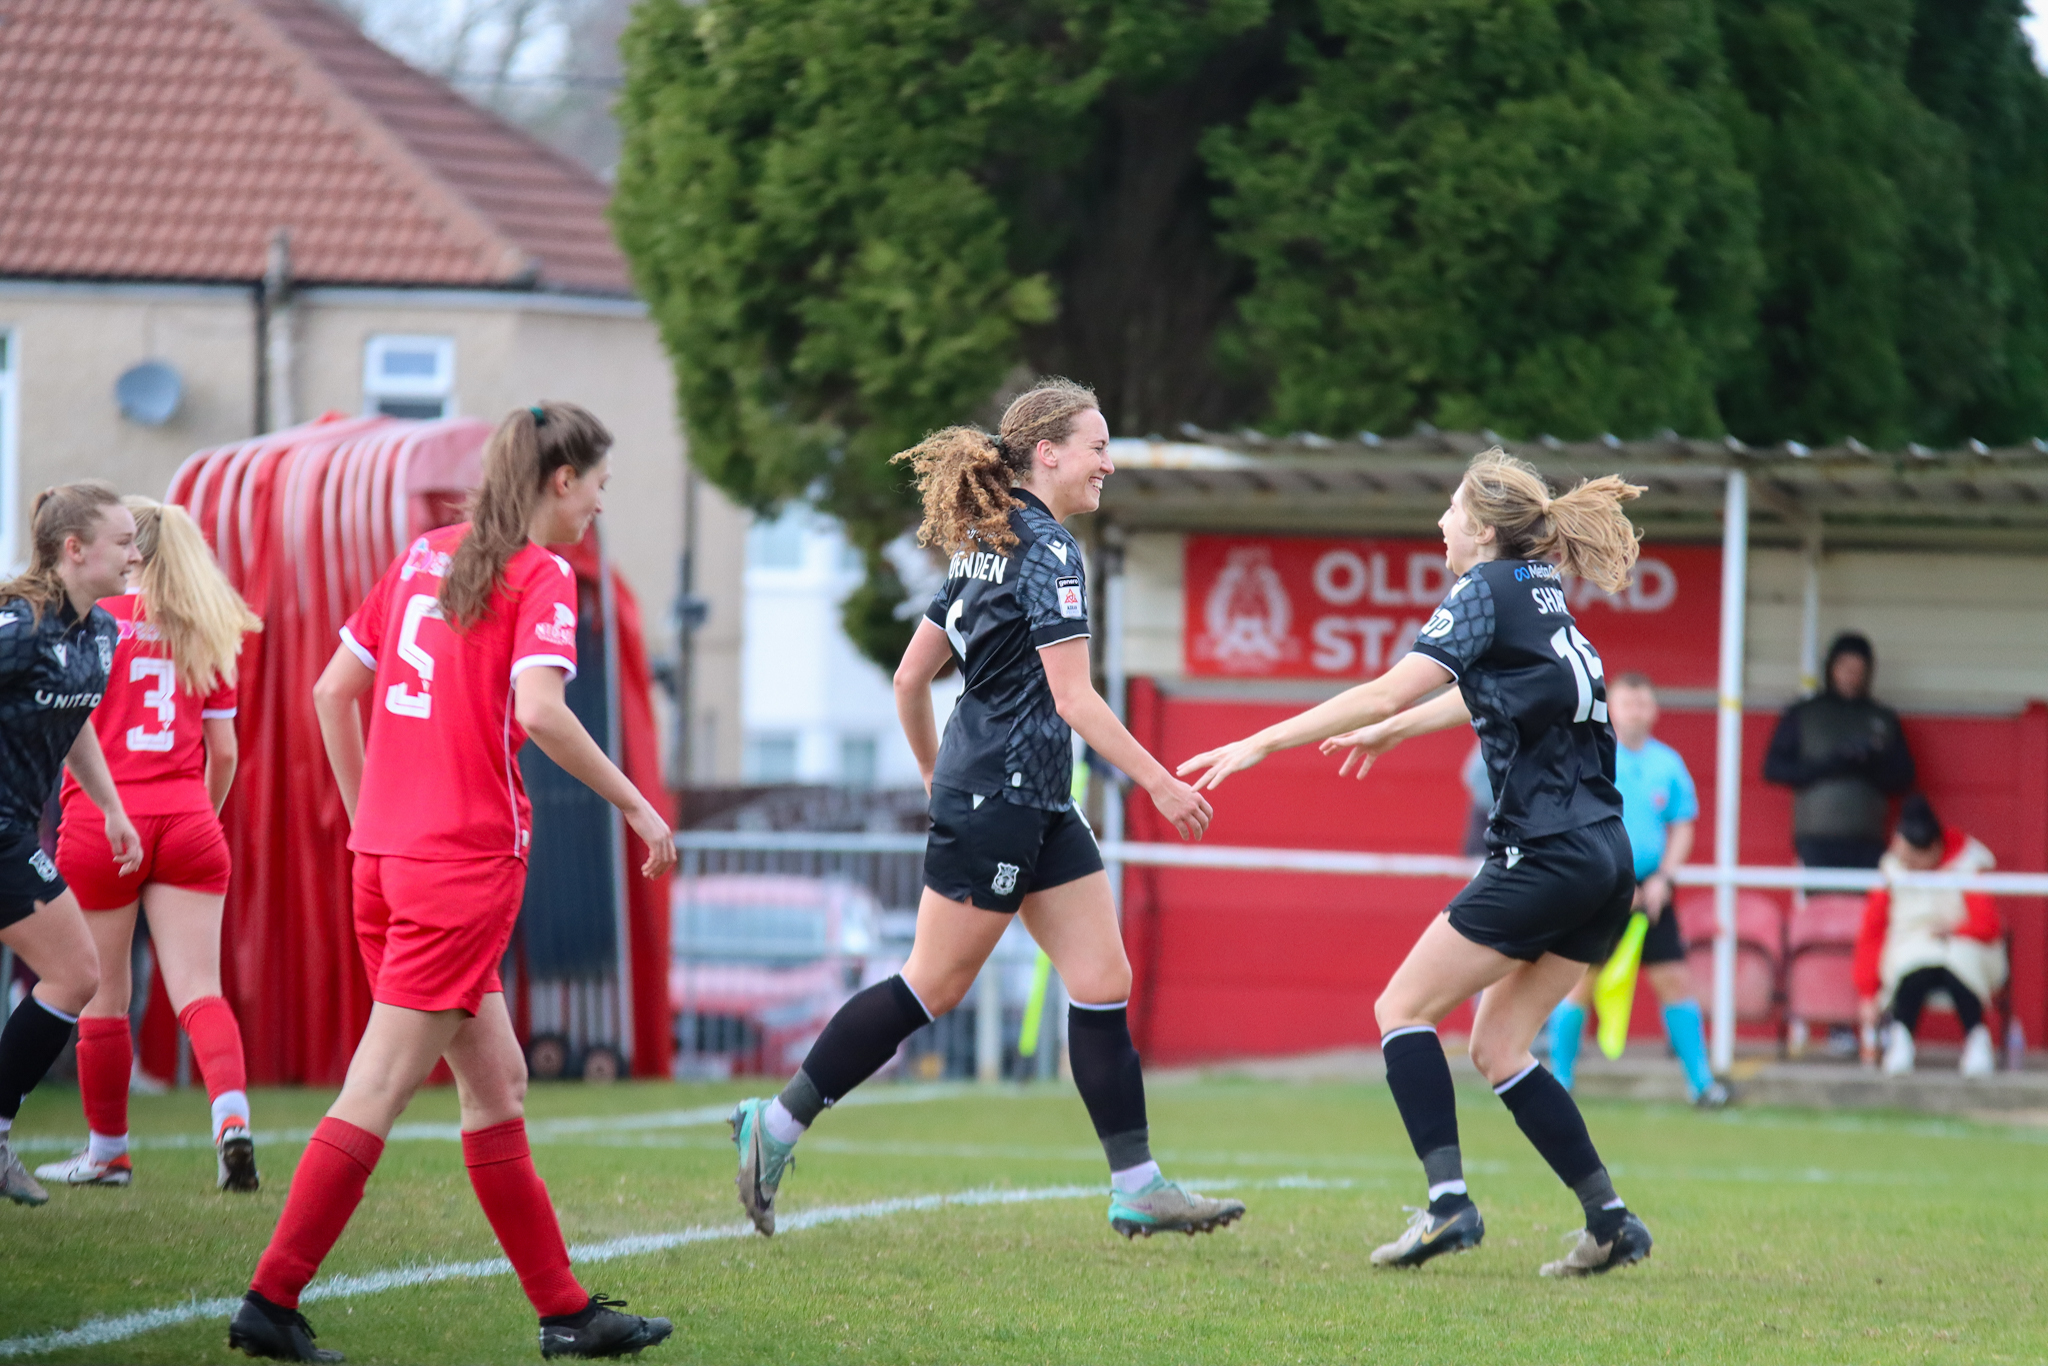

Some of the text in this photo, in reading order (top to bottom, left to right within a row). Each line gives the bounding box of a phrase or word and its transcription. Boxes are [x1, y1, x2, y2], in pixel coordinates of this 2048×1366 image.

[1313, 552, 1456, 607] OLD
[385, 593, 446, 720] 5
[34, 689, 102, 709] UNITED
[126, 657, 175, 752] 3
